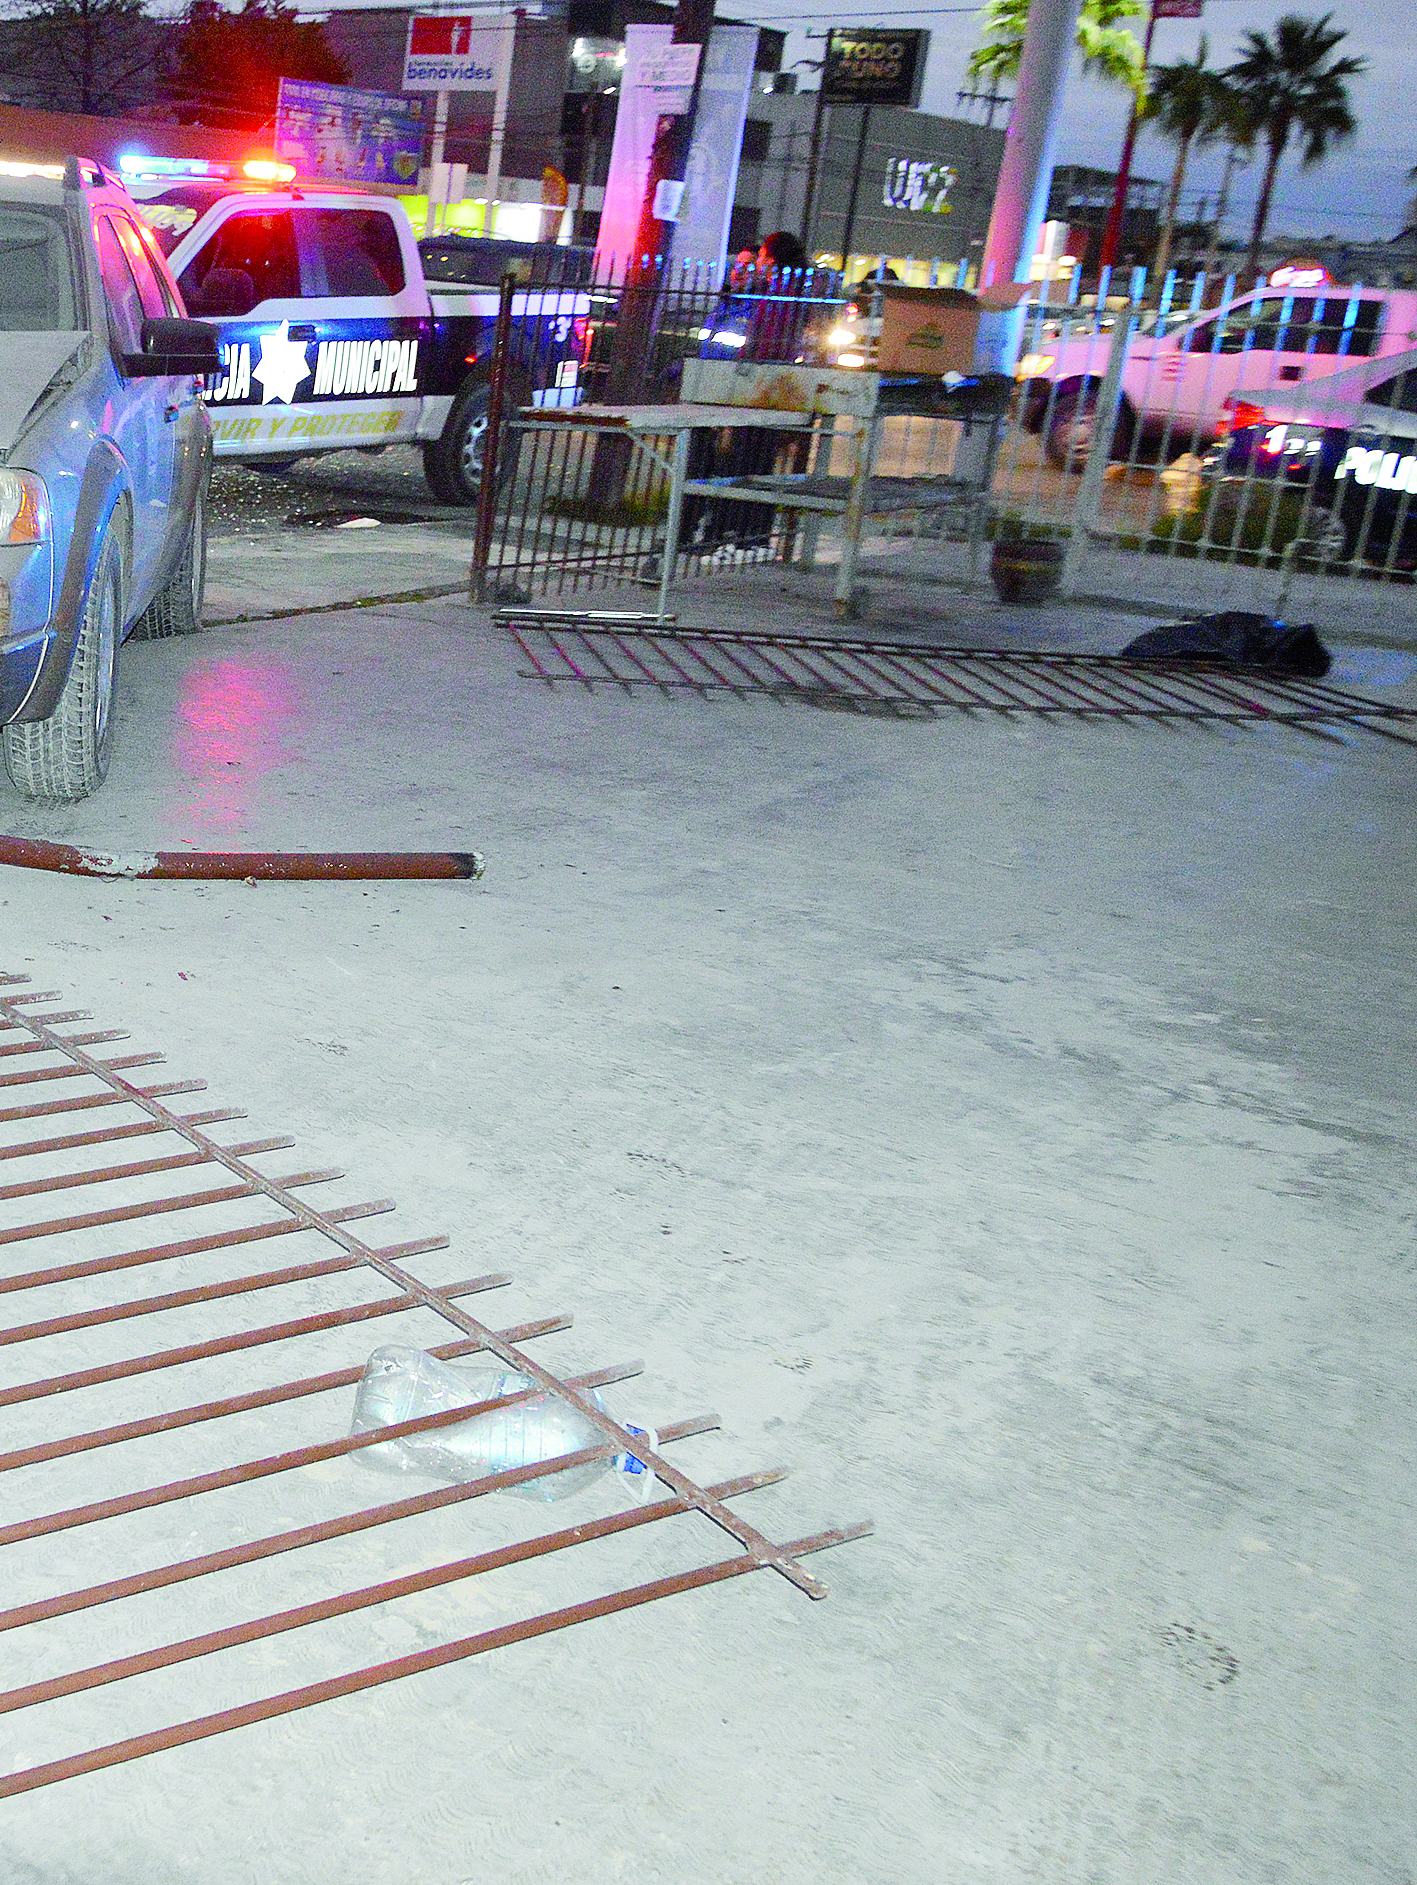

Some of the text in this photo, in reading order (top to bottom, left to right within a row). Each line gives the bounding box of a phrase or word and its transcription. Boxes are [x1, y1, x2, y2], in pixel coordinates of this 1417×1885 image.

[313, 339, 418, 396] MUNICIPAL
[268, 416, 286, 438] Y
[289, 410, 405, 438] PROTEGER
